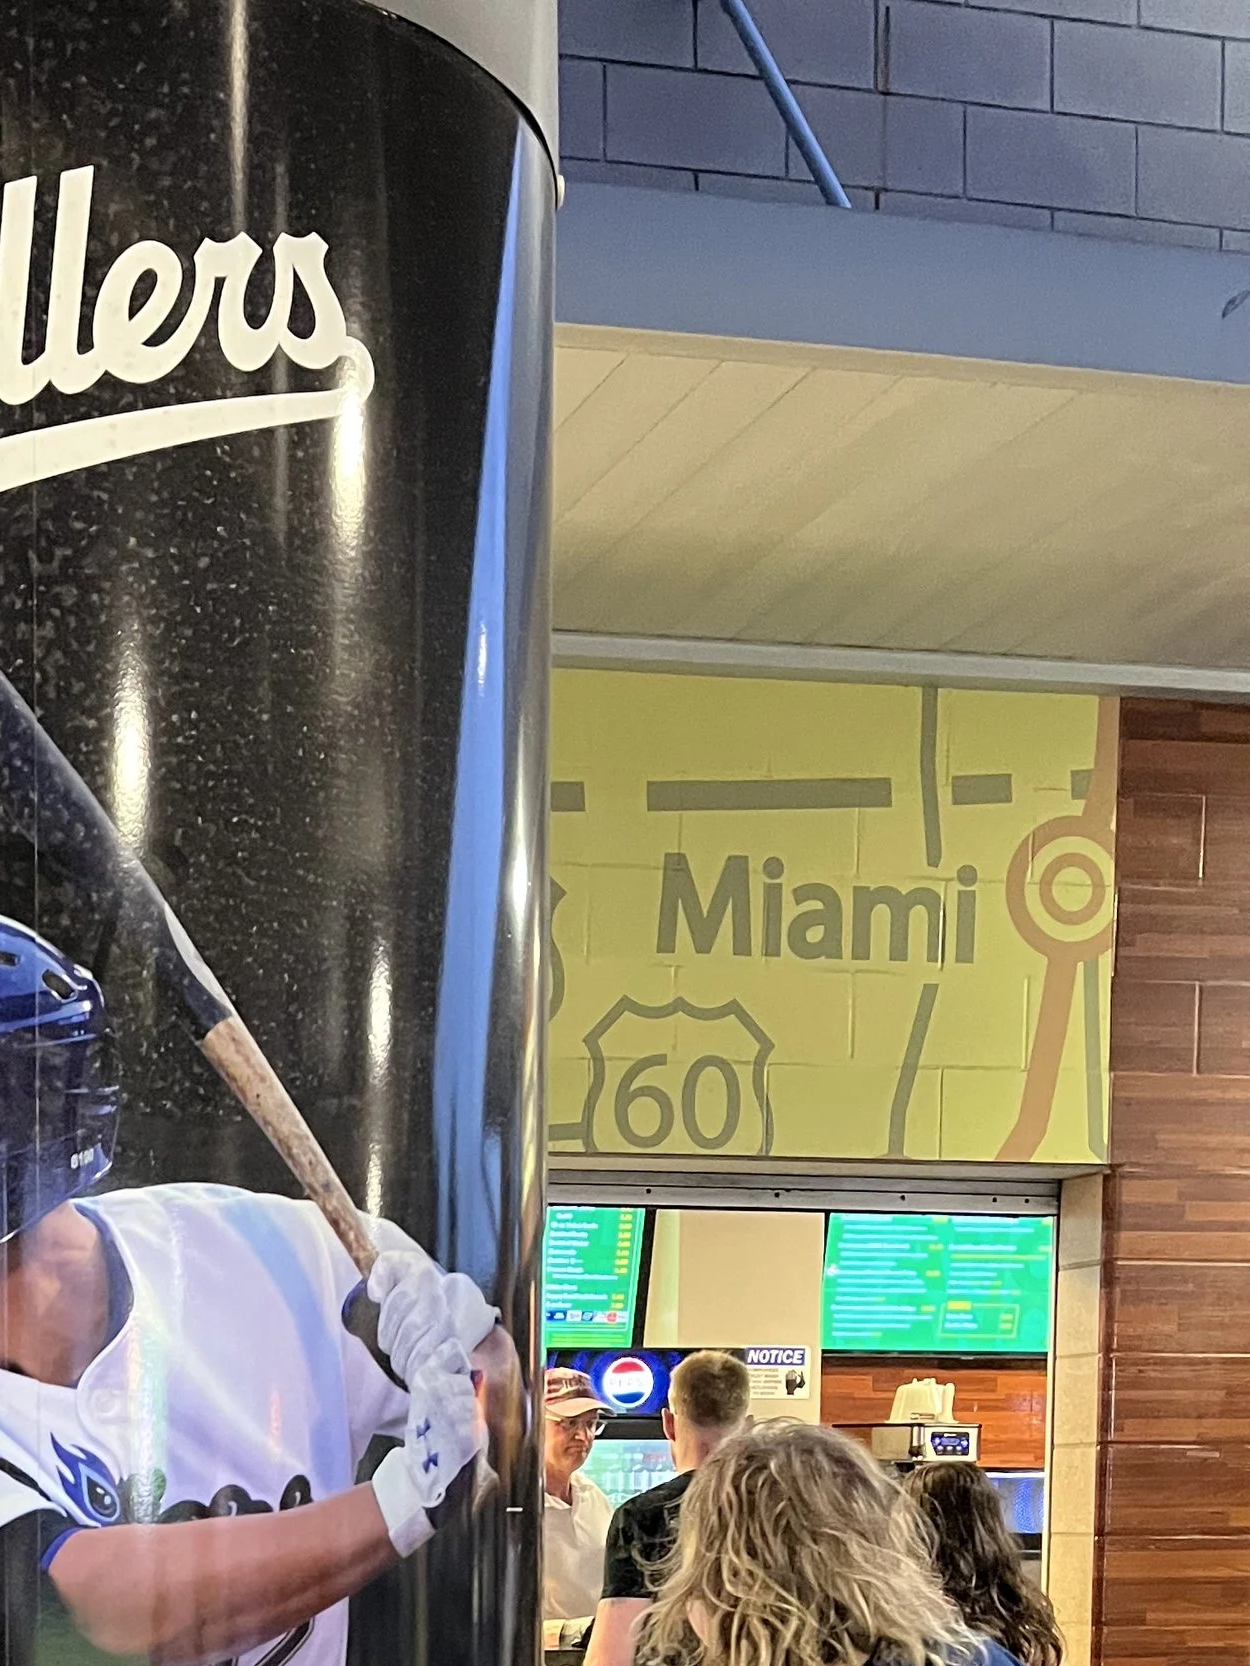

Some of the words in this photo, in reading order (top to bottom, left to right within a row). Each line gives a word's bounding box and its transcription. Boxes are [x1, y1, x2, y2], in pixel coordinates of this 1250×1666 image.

[655, 851, 977, 966] Miami
[613, 1053, 742, 1150] 60
[747, 1349, 804, 1364] NOTICE
